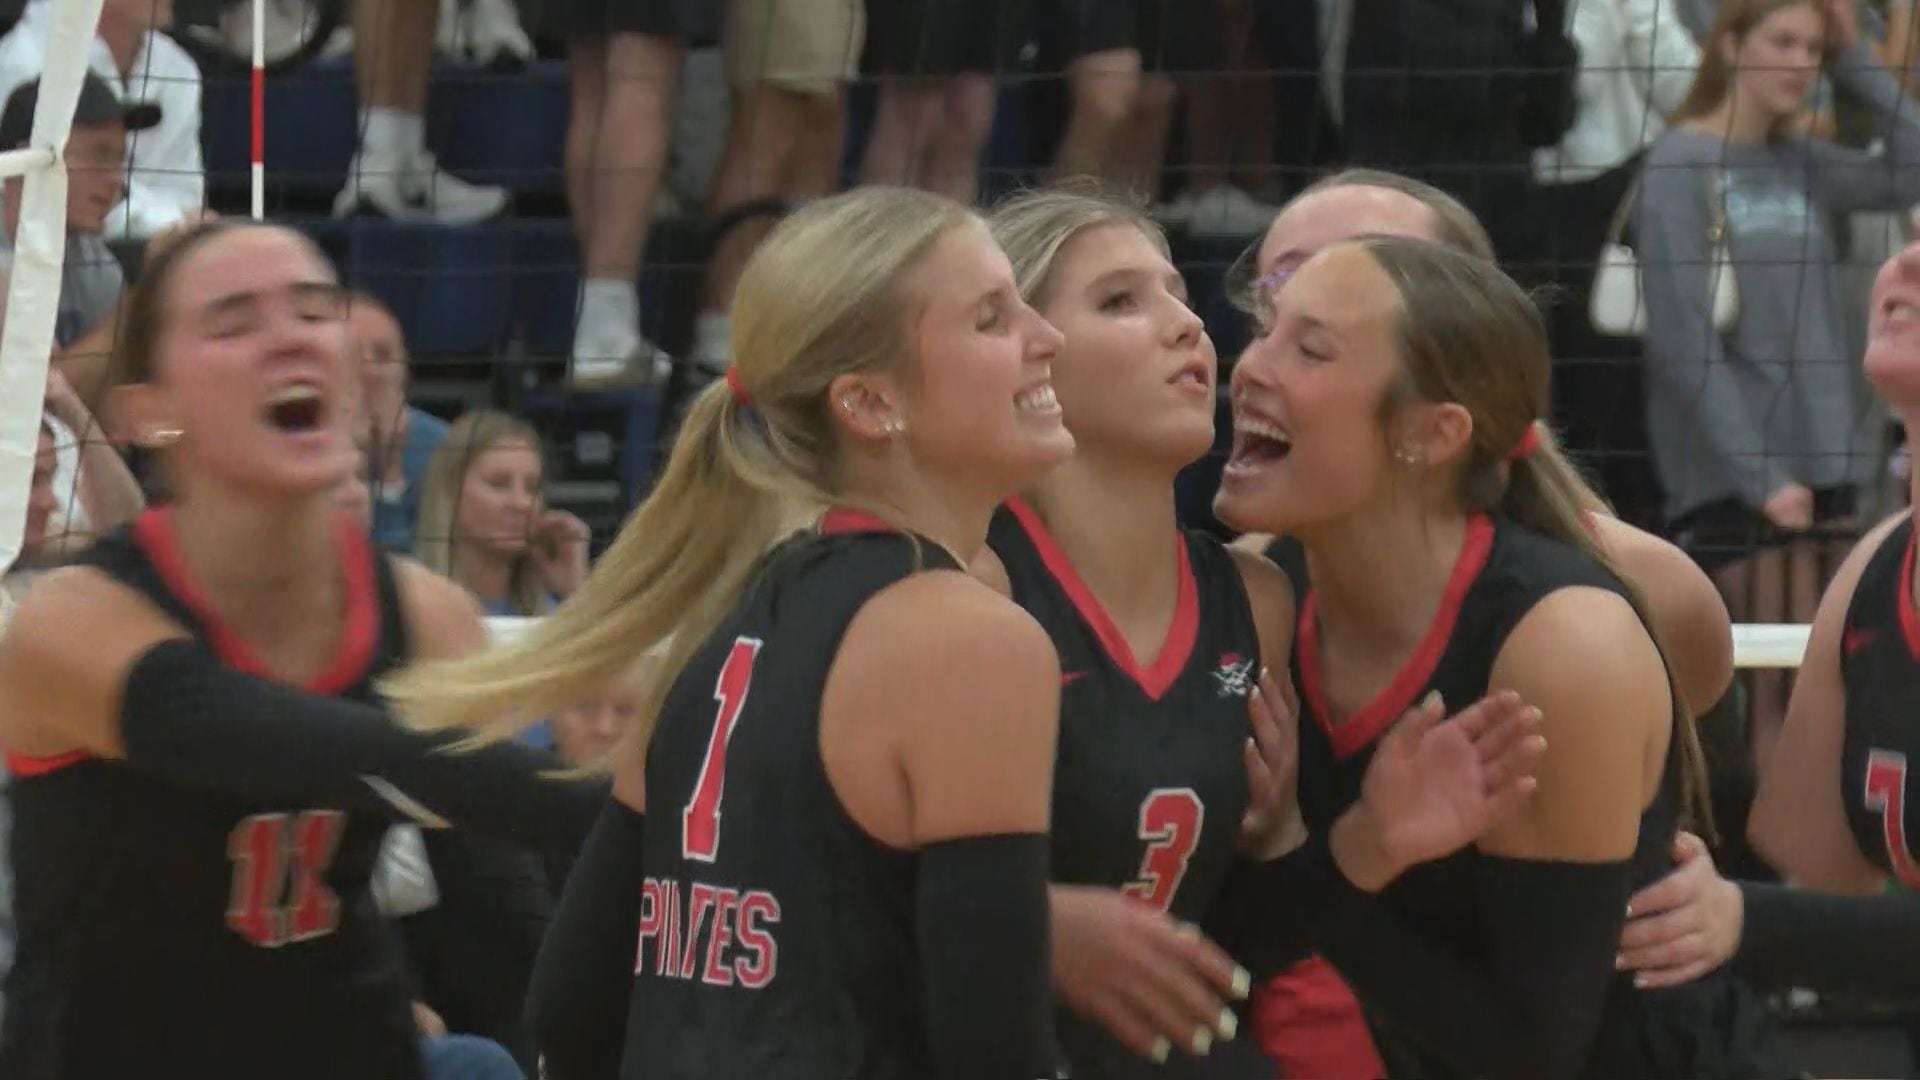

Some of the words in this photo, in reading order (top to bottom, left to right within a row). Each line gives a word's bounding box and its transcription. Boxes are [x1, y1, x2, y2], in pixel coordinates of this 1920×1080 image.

[682, 635, 764, 864] 1
[223, 809, 346, 949] 11
[1119, 787, 1205, 914] 3
